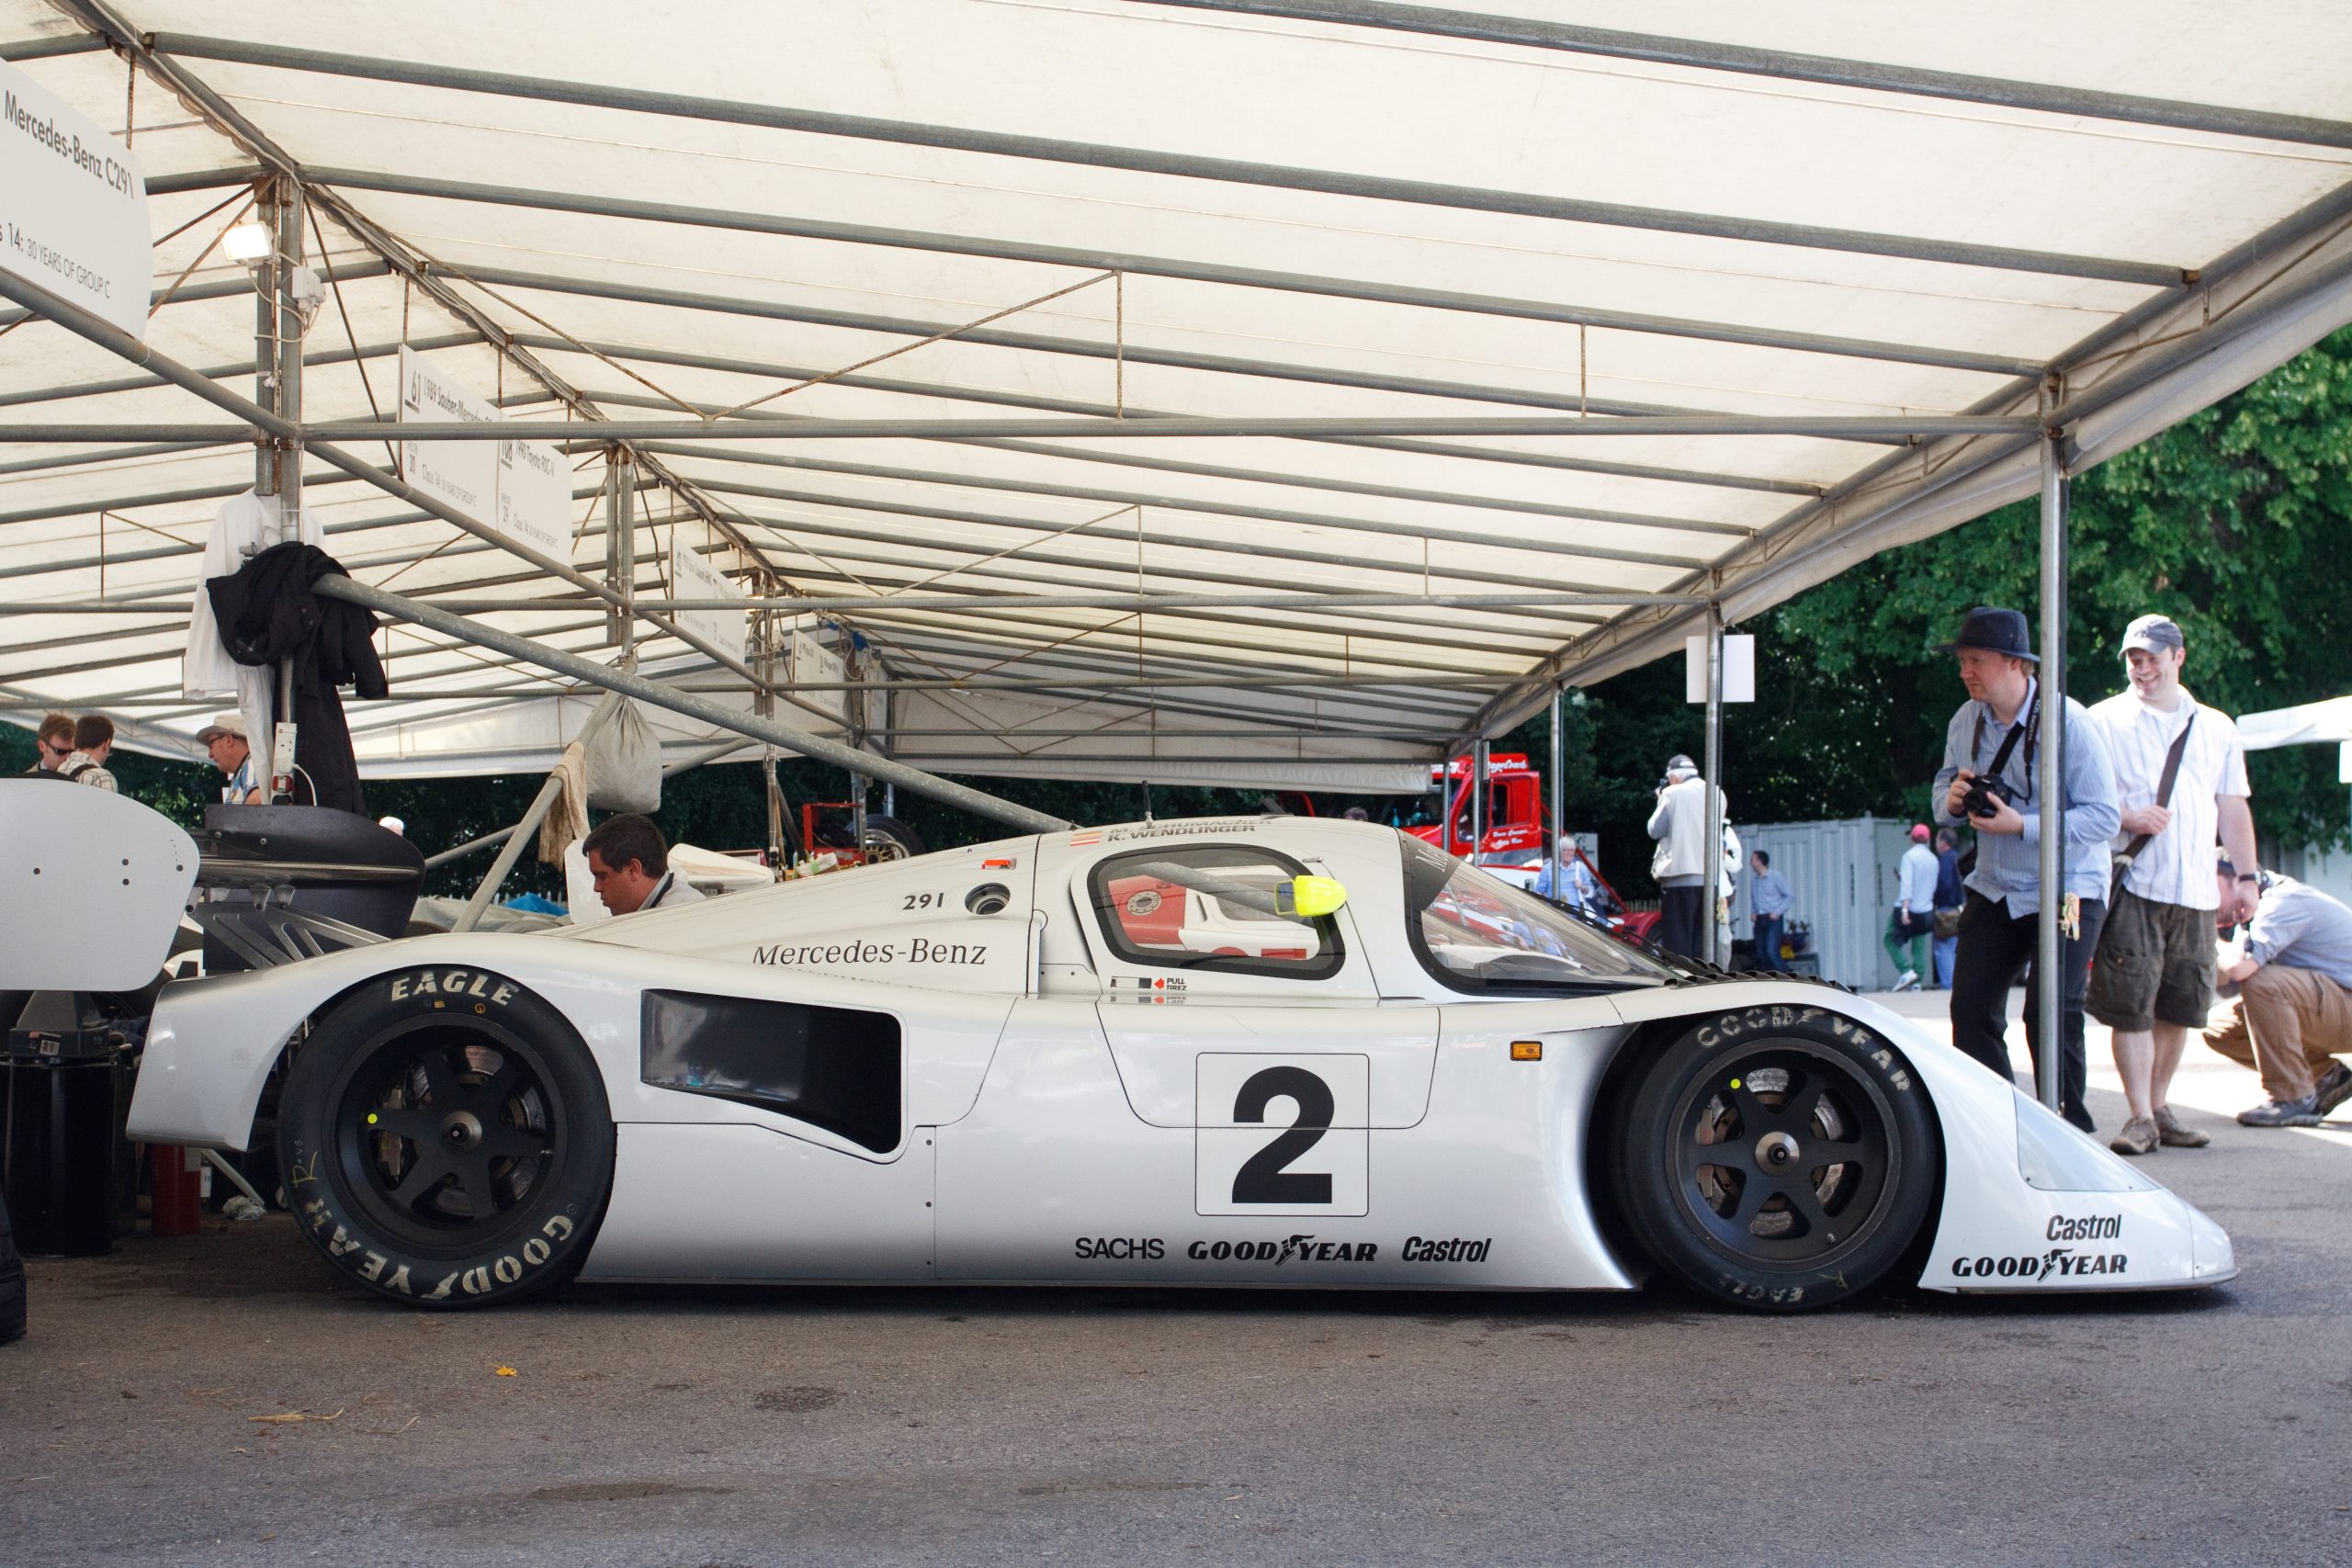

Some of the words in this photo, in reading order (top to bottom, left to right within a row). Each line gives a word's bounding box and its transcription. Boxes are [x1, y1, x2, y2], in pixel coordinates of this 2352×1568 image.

[5, 90, 103, 180] Mercedes-Benz
[105, 156, 134, 199] C291
[8, 222, 24, 254] 14:
[27, 239, 38, 260] 30
[39, 245, 62, 271] YEARS
[63, 258, 74, 278] OF
[76, 265, 104, 295] GROUP
[104, 280, 110, 299] C
[412, 369, 421, 405] 61
[1108, 834, 1125, 842] K.
[1131, 825, 1256, 840] WENDLINGER
[902, 892, 944, 911] 291
[752, 938, 988, 965] Mercedes-Benz
[390, 971, 519, 1006] EAGLE
[1231, 1066, 1335, 1203] 2
[2046, 1213, 2122, 1241] Castrol
[1074, 1237, 1165, 1259] SACHS
[1401, 1235, 1492, 1263] Castrol
